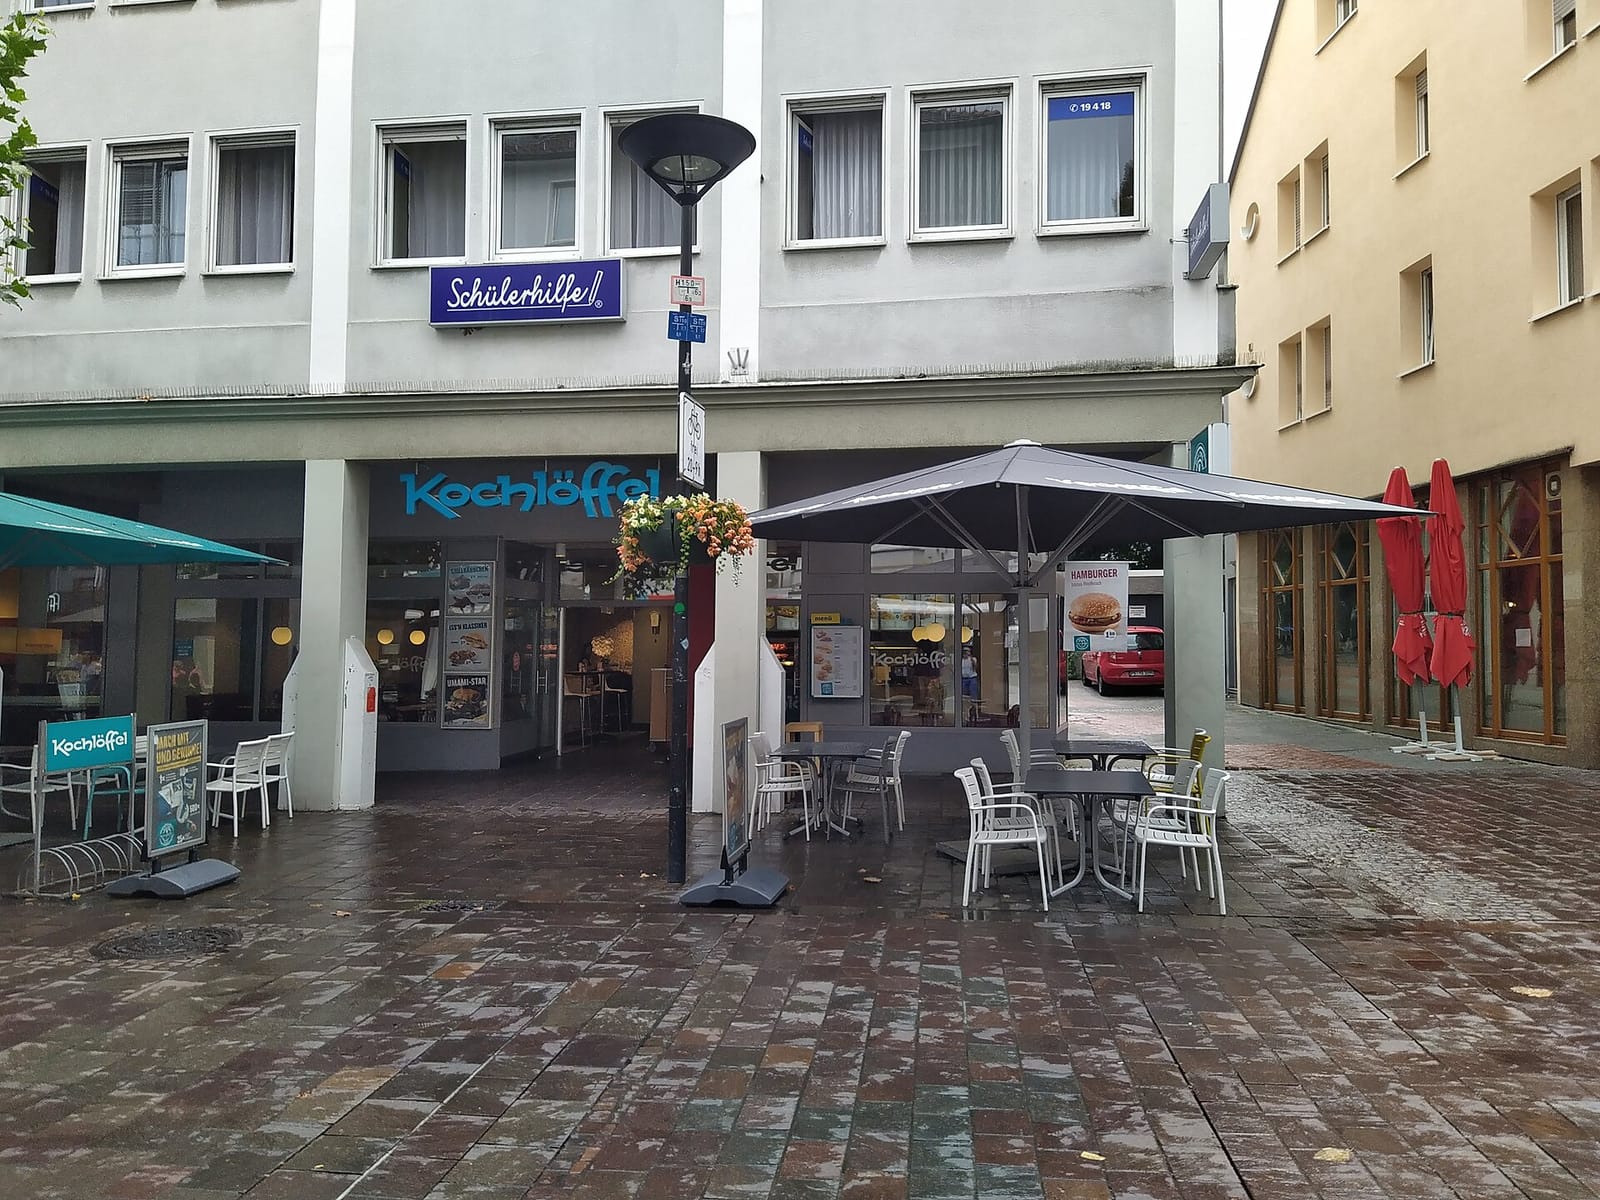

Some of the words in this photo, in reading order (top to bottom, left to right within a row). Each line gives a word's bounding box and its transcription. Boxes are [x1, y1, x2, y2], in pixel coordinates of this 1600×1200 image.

[400, 461, 660, 519] Kochlöffel
[1071, 568, 1118, 580] HAMBURGER
[447, 676, 487, 688] UMAMI-STAR
[52, 730, 128, 757] Kochlöffel
